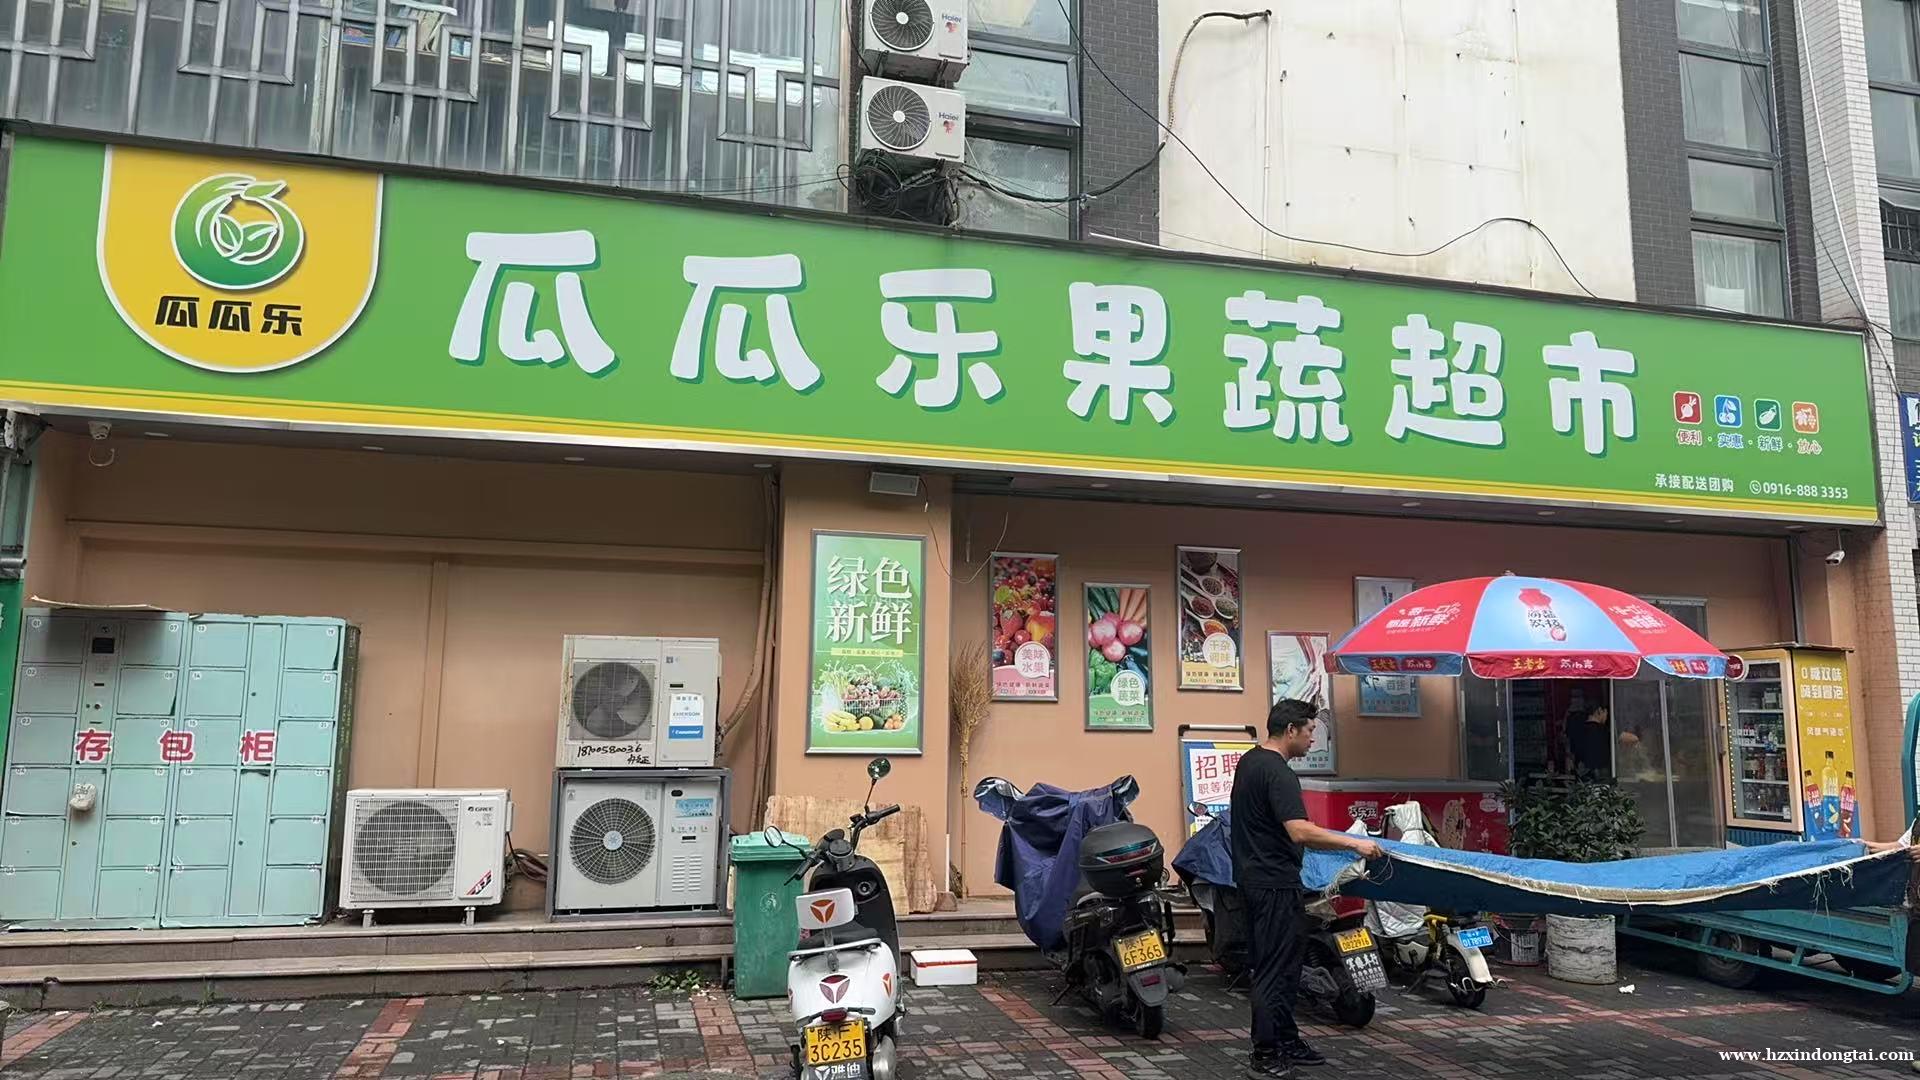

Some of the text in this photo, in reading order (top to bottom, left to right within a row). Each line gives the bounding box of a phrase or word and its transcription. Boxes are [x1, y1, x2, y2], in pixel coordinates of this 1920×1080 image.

[942, 13, 961, 23] Haier
[938, 112, 959, 121] Haier
[155, 295, 303, 336] 瓜瓜乐
[448, 229, 1637, 456] 瓜瓜乐果蔬超市
[1676, 429, 1823, 455] 便利 实惠 新鲜 放心
[1655, 473, 1735, 493] 承接配送团购
[1763, 483, 1849, 499] 0916-888 3353
[827, 555, 913, 598] 绿色
[825, 599, 913, 645] 新鲜
[75, 729, 276, 764] 存包柜
[1195, 751, 1242, 780] 招聘
[1123, 944, 1162, 966] 6F365
[810, 1038, 862, 1063] 3C235
